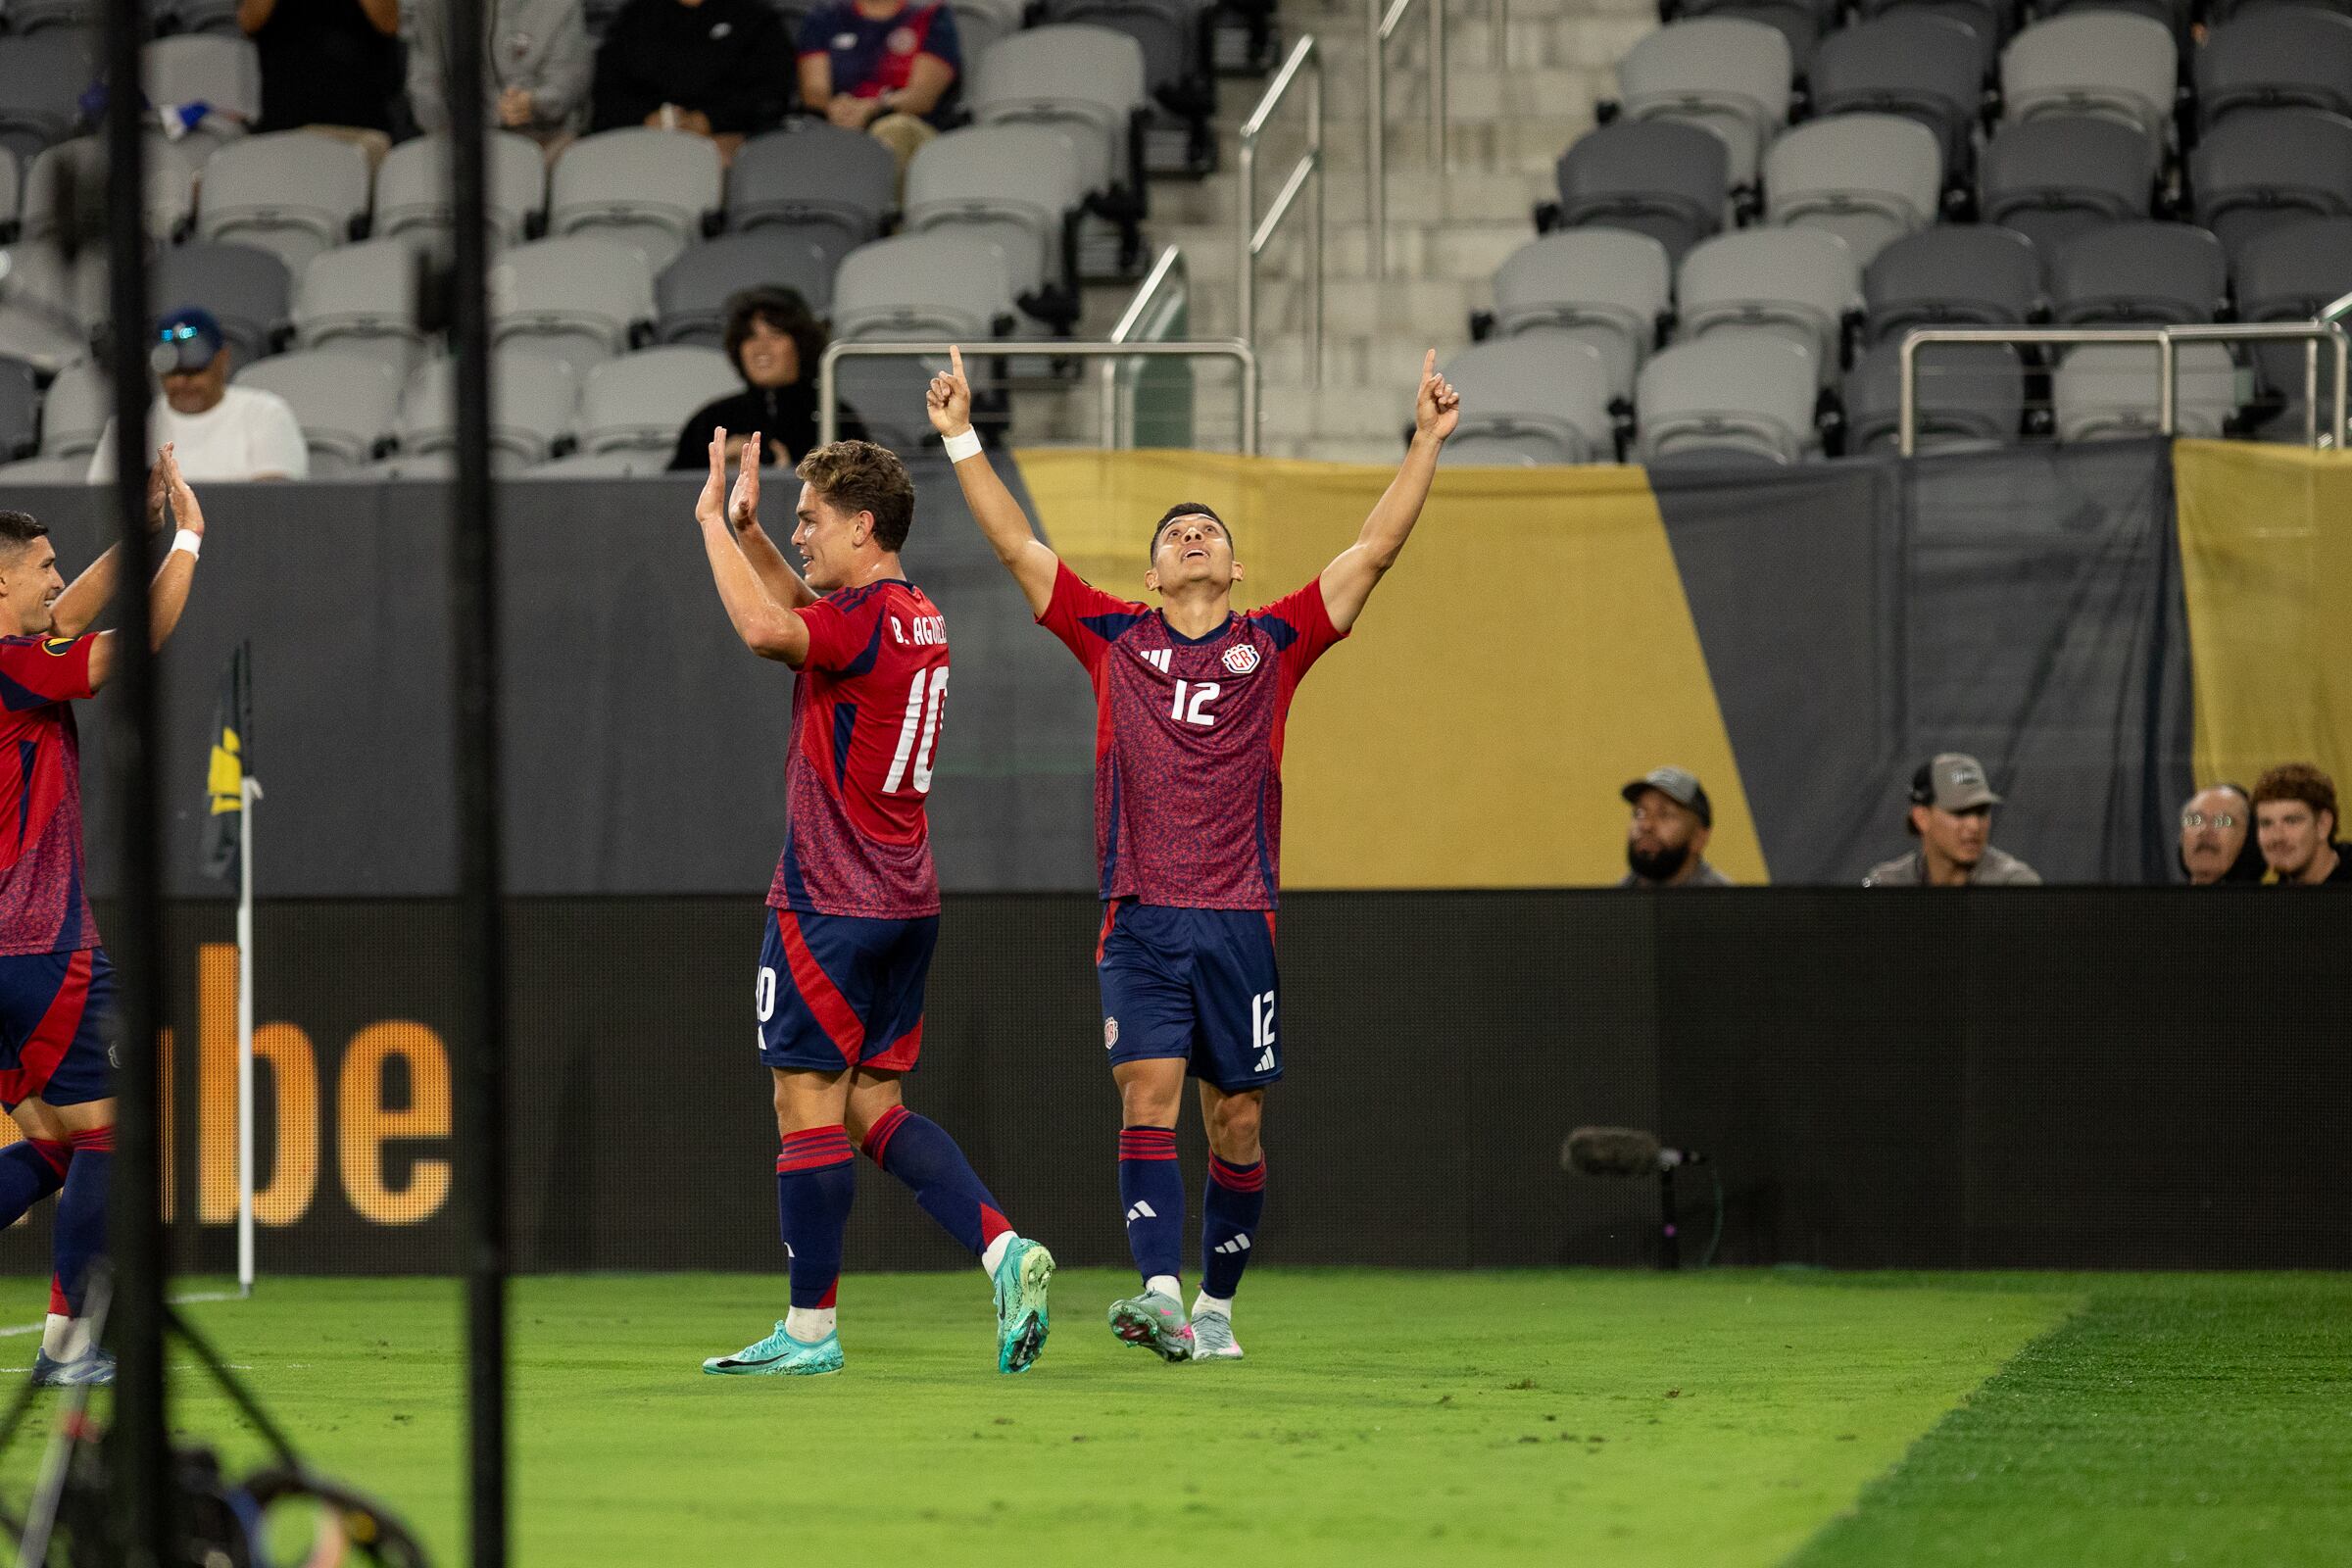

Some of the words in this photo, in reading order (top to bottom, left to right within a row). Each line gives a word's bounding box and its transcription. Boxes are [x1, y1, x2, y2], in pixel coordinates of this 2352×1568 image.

[891, 616, 910, 645] B.
[1171, 678, 1221, 726] 12
[882, 666, 950, 794] 10
[1251, 990, 1276, 1049] 12
